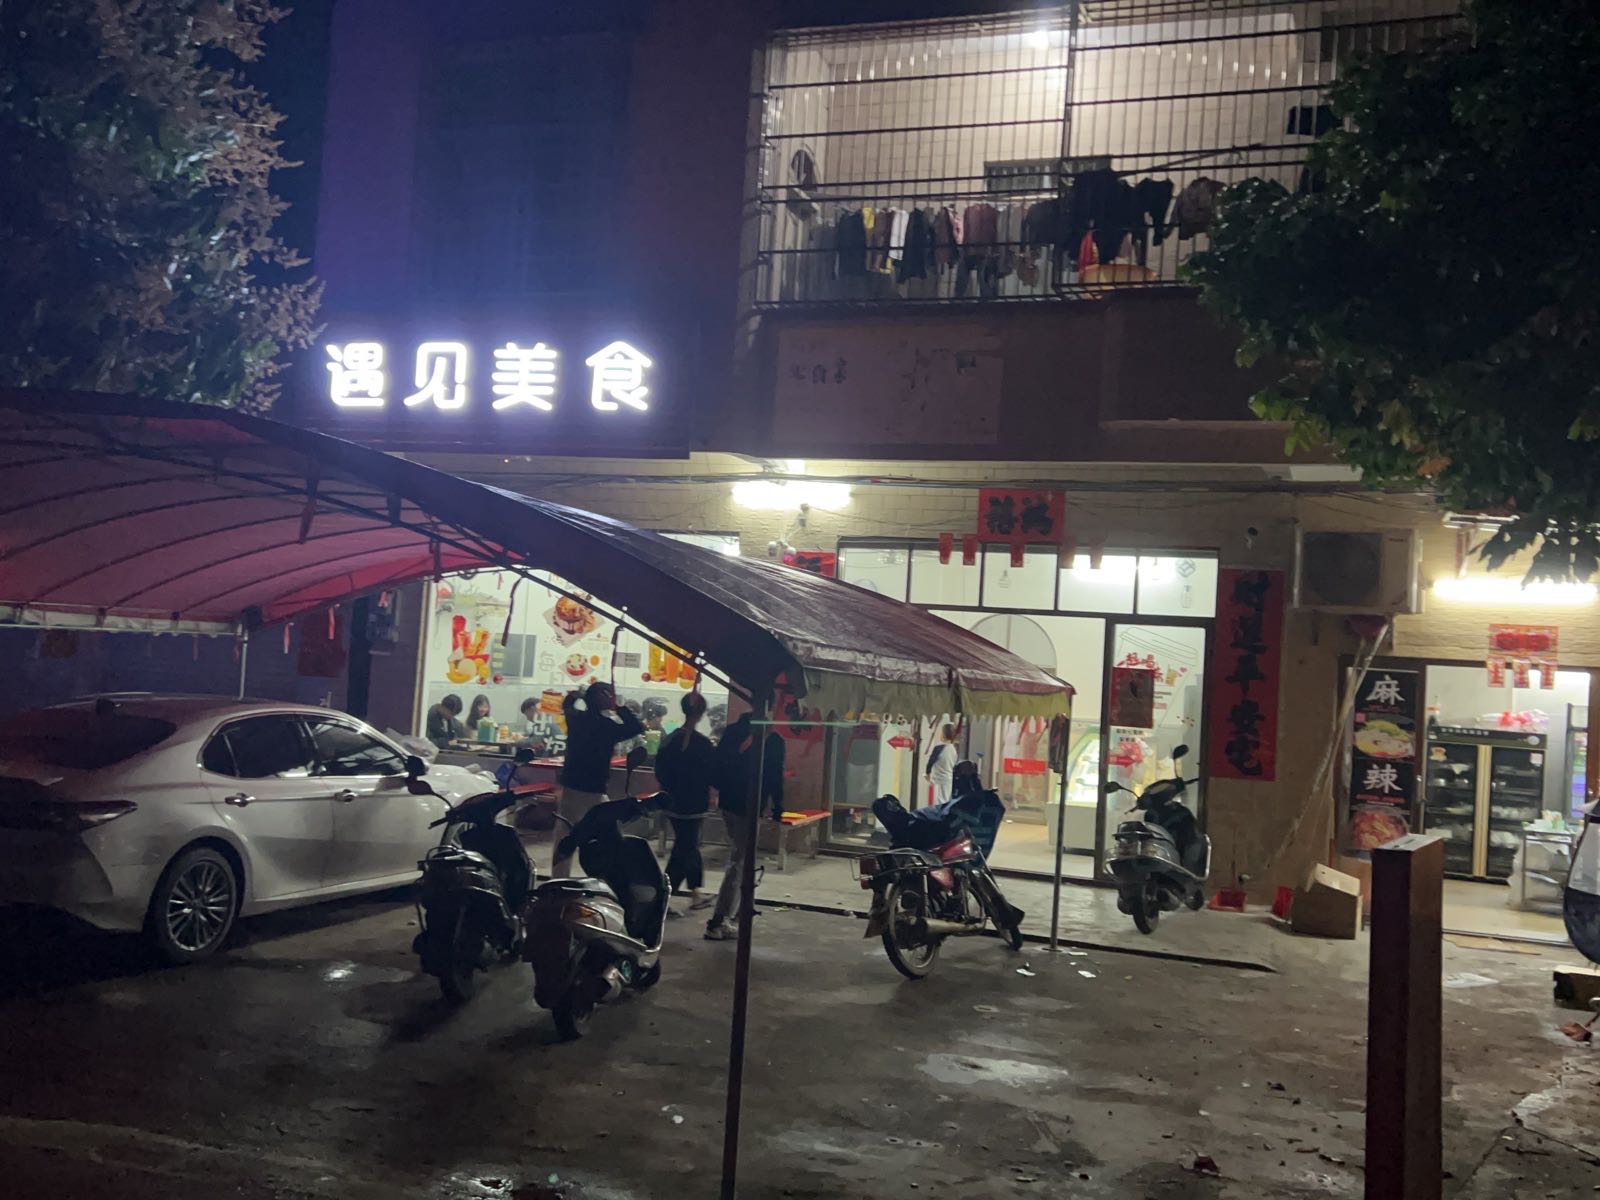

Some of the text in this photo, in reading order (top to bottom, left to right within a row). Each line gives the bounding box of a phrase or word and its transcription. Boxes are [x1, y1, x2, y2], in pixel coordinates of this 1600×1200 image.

[325, 340, 652, 411] 遇见美食
[1365, 674, 1406, 706] 麻
[1363, 763, 1403, 794] 辣
